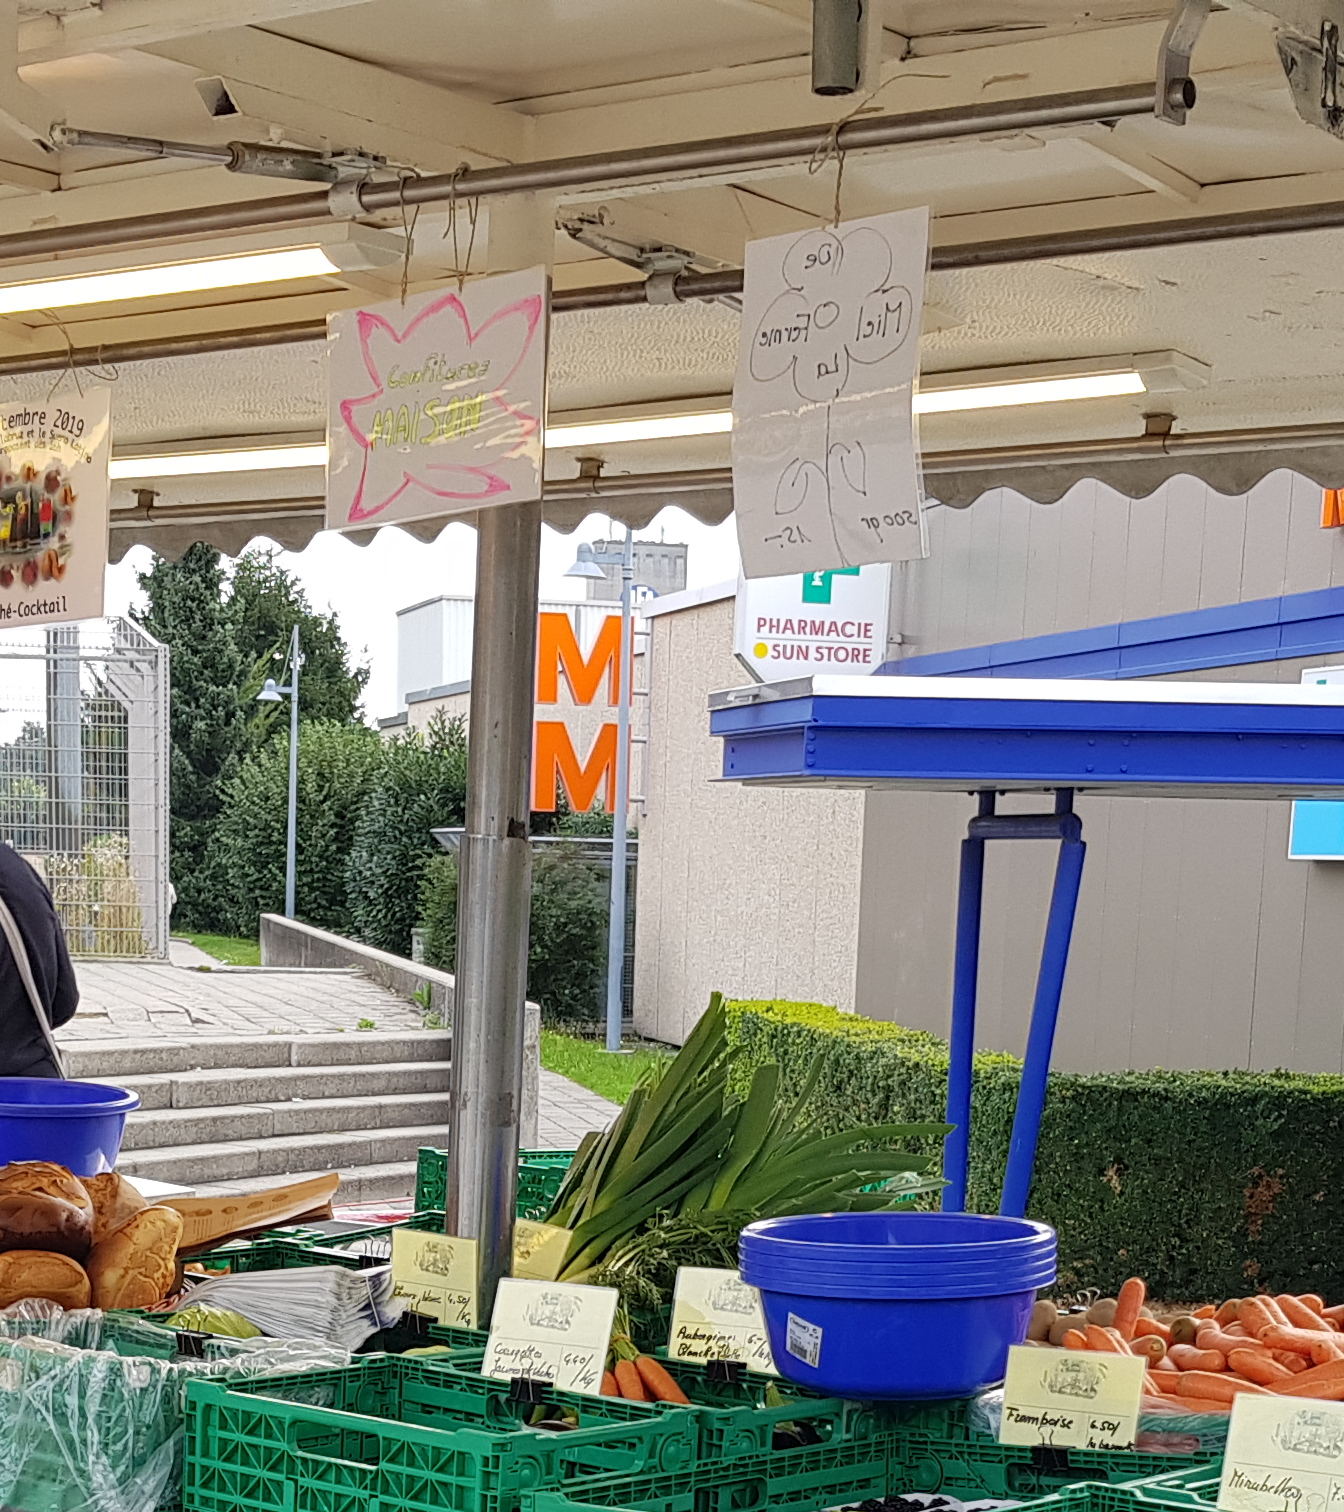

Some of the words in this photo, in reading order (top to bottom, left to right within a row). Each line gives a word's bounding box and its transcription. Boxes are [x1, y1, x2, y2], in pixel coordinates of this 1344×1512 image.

[53, 408, 85, 438] 2019
[371, 391, 486, 452] MAISON
[756, 617, 874, 639] PHARMACIE
[770, 643, 810, 661] SUN
[814, 645, 872, 664] STORE
[1006, 1406, 1074, 1431] Framboise
